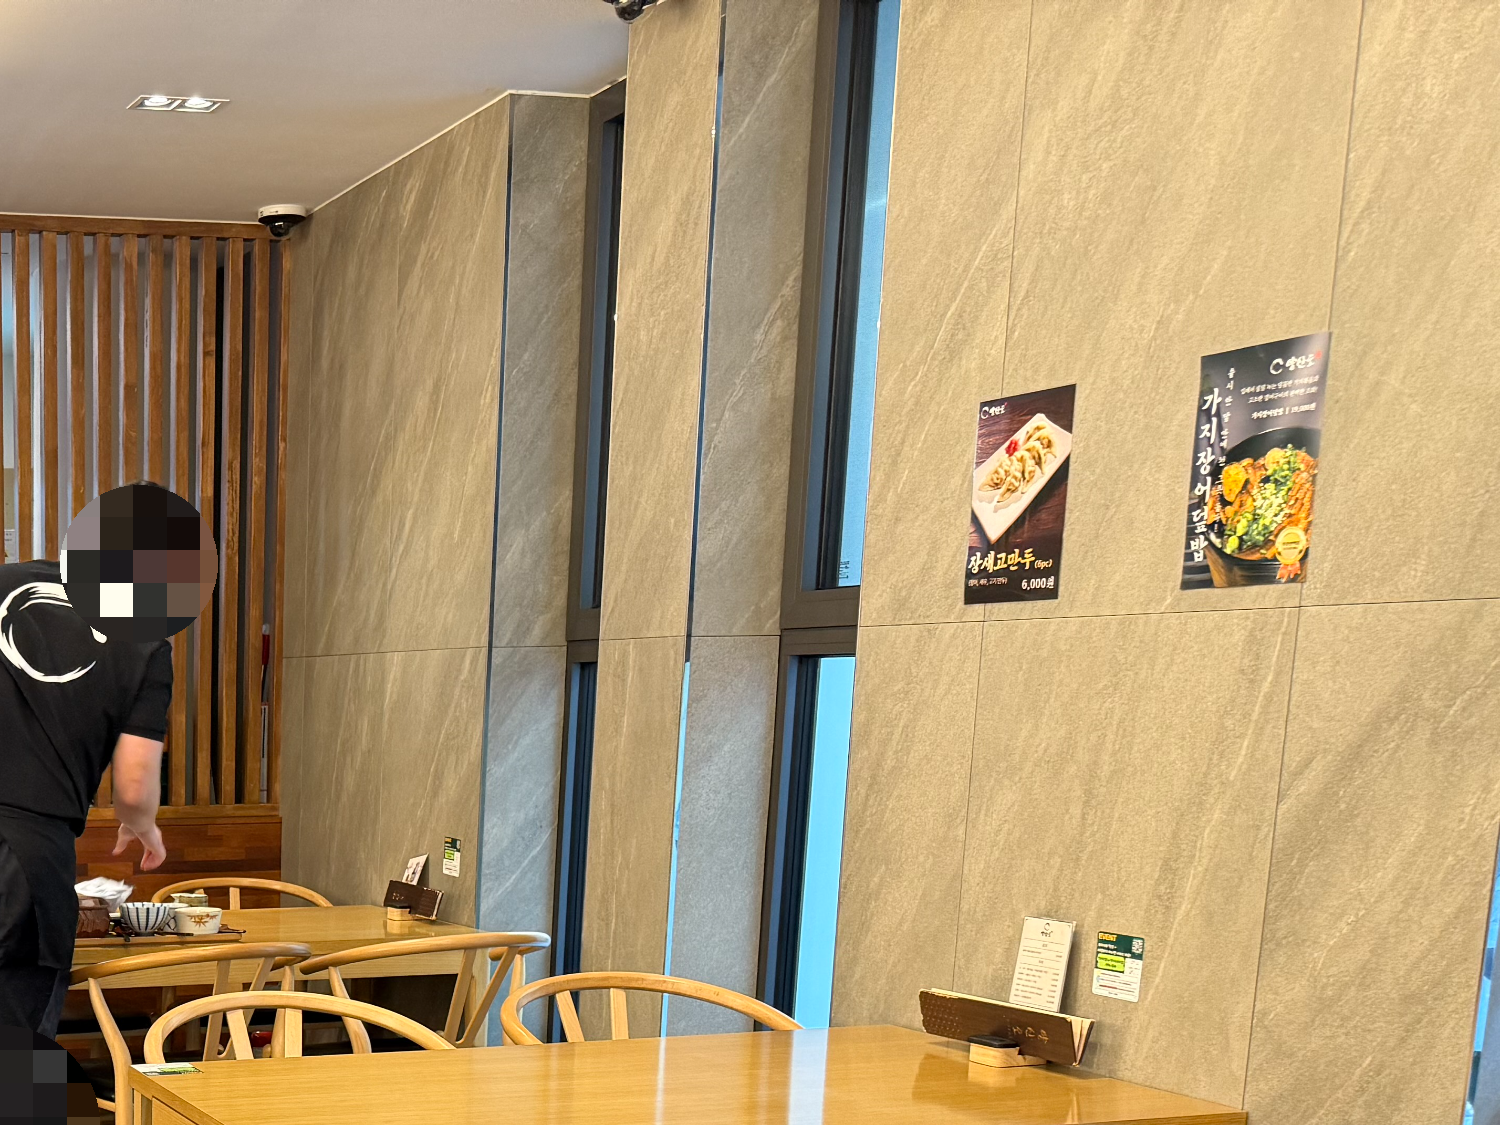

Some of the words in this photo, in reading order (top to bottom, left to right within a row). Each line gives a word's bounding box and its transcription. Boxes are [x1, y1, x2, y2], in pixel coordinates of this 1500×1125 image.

[1190, 388, 1223, 562] 가지장어덮밥
[968, 548, 1036, 574] 장새고만두
[1021, 575, 1055, 590] 6,000원
